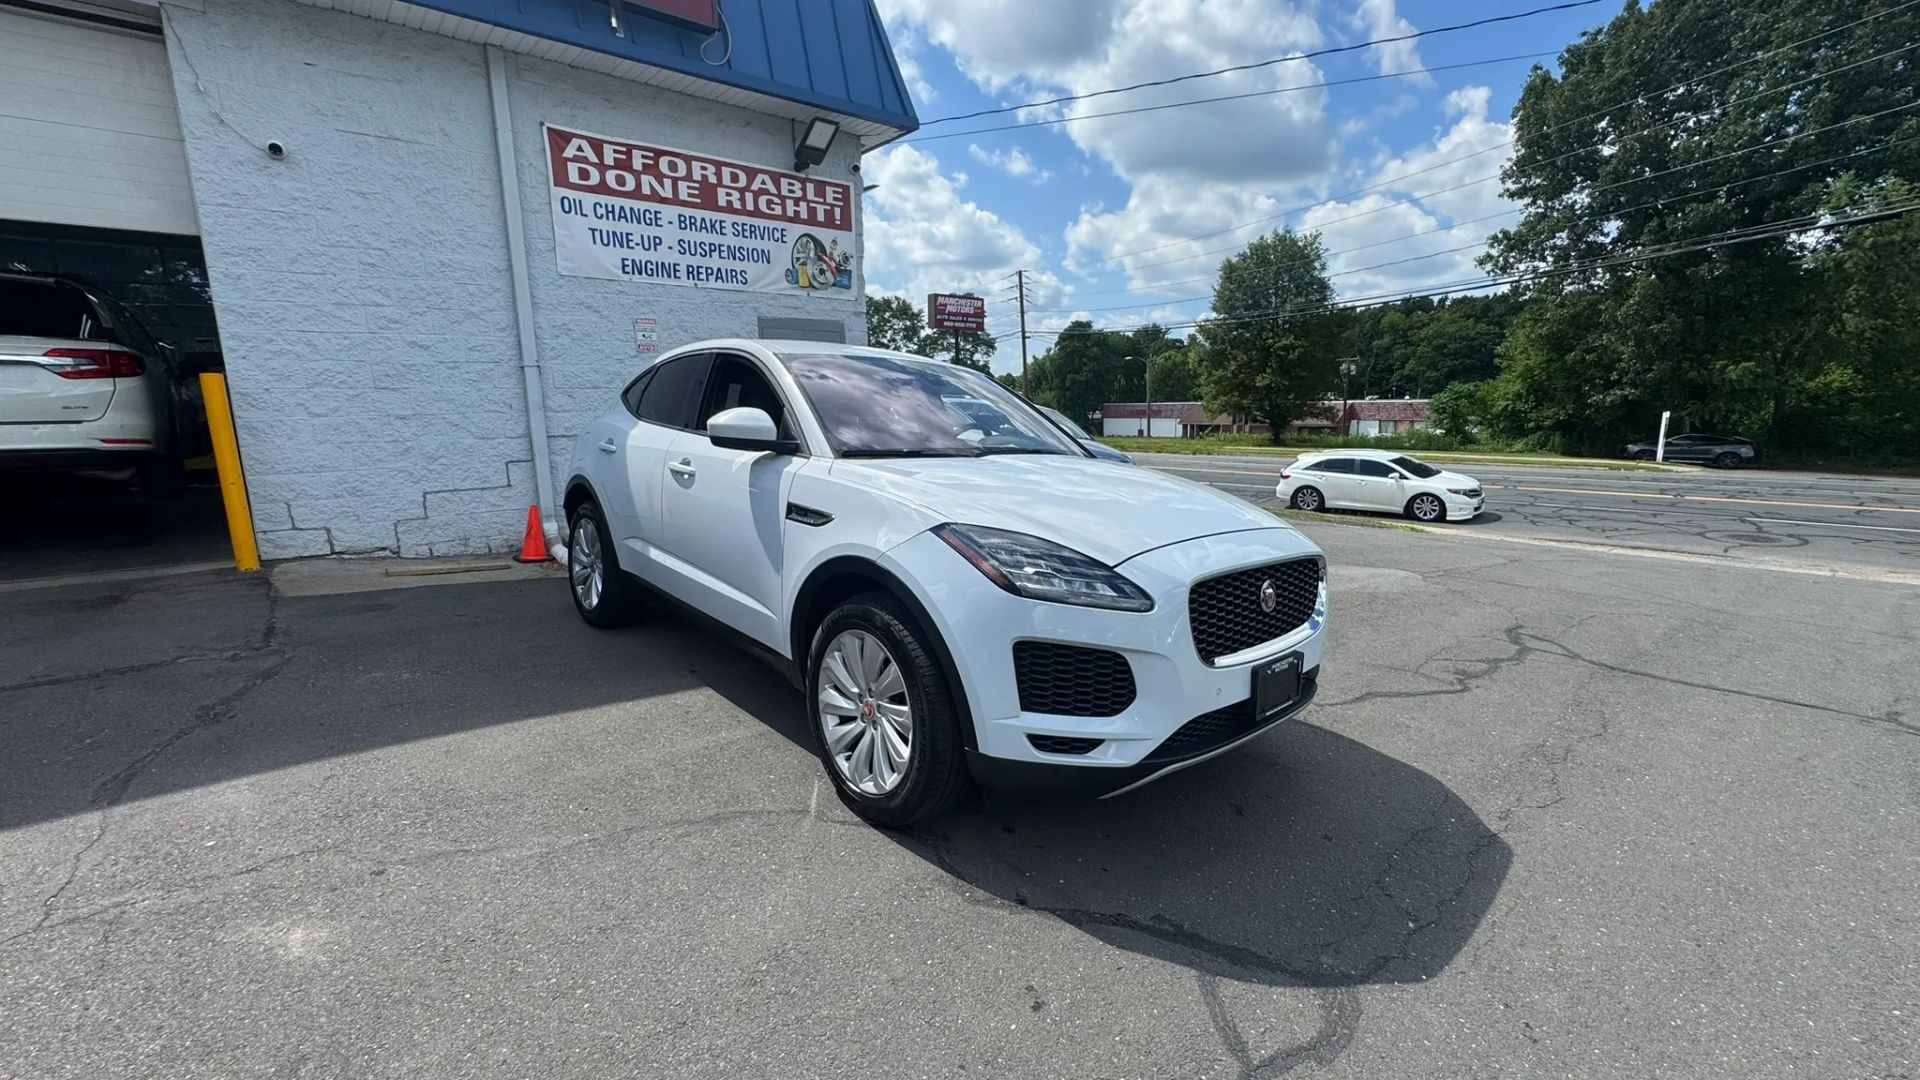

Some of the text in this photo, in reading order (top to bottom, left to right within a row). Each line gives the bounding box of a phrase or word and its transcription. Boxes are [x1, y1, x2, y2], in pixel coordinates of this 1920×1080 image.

[562, 137, 844, 205] AFFORDABLE
[566, 161, 841, 225] DONE RIGHT!
[560, 195, 588, 218] OIL
[593, 202, 663, 228] CHANGE
[678, 213, 727, 237] BRAKE
[732, 222, 788, 244] SERVICE
[588, 227, 662, 252] TUNE-UP
[677, 239, 771, 265] SUSPENSION
[621, 258, 748, 285] ENGINE REPAIRS
[936, 296, 982, 307] MANCHESTER
[945, 305, 974, 313] MOTORS
